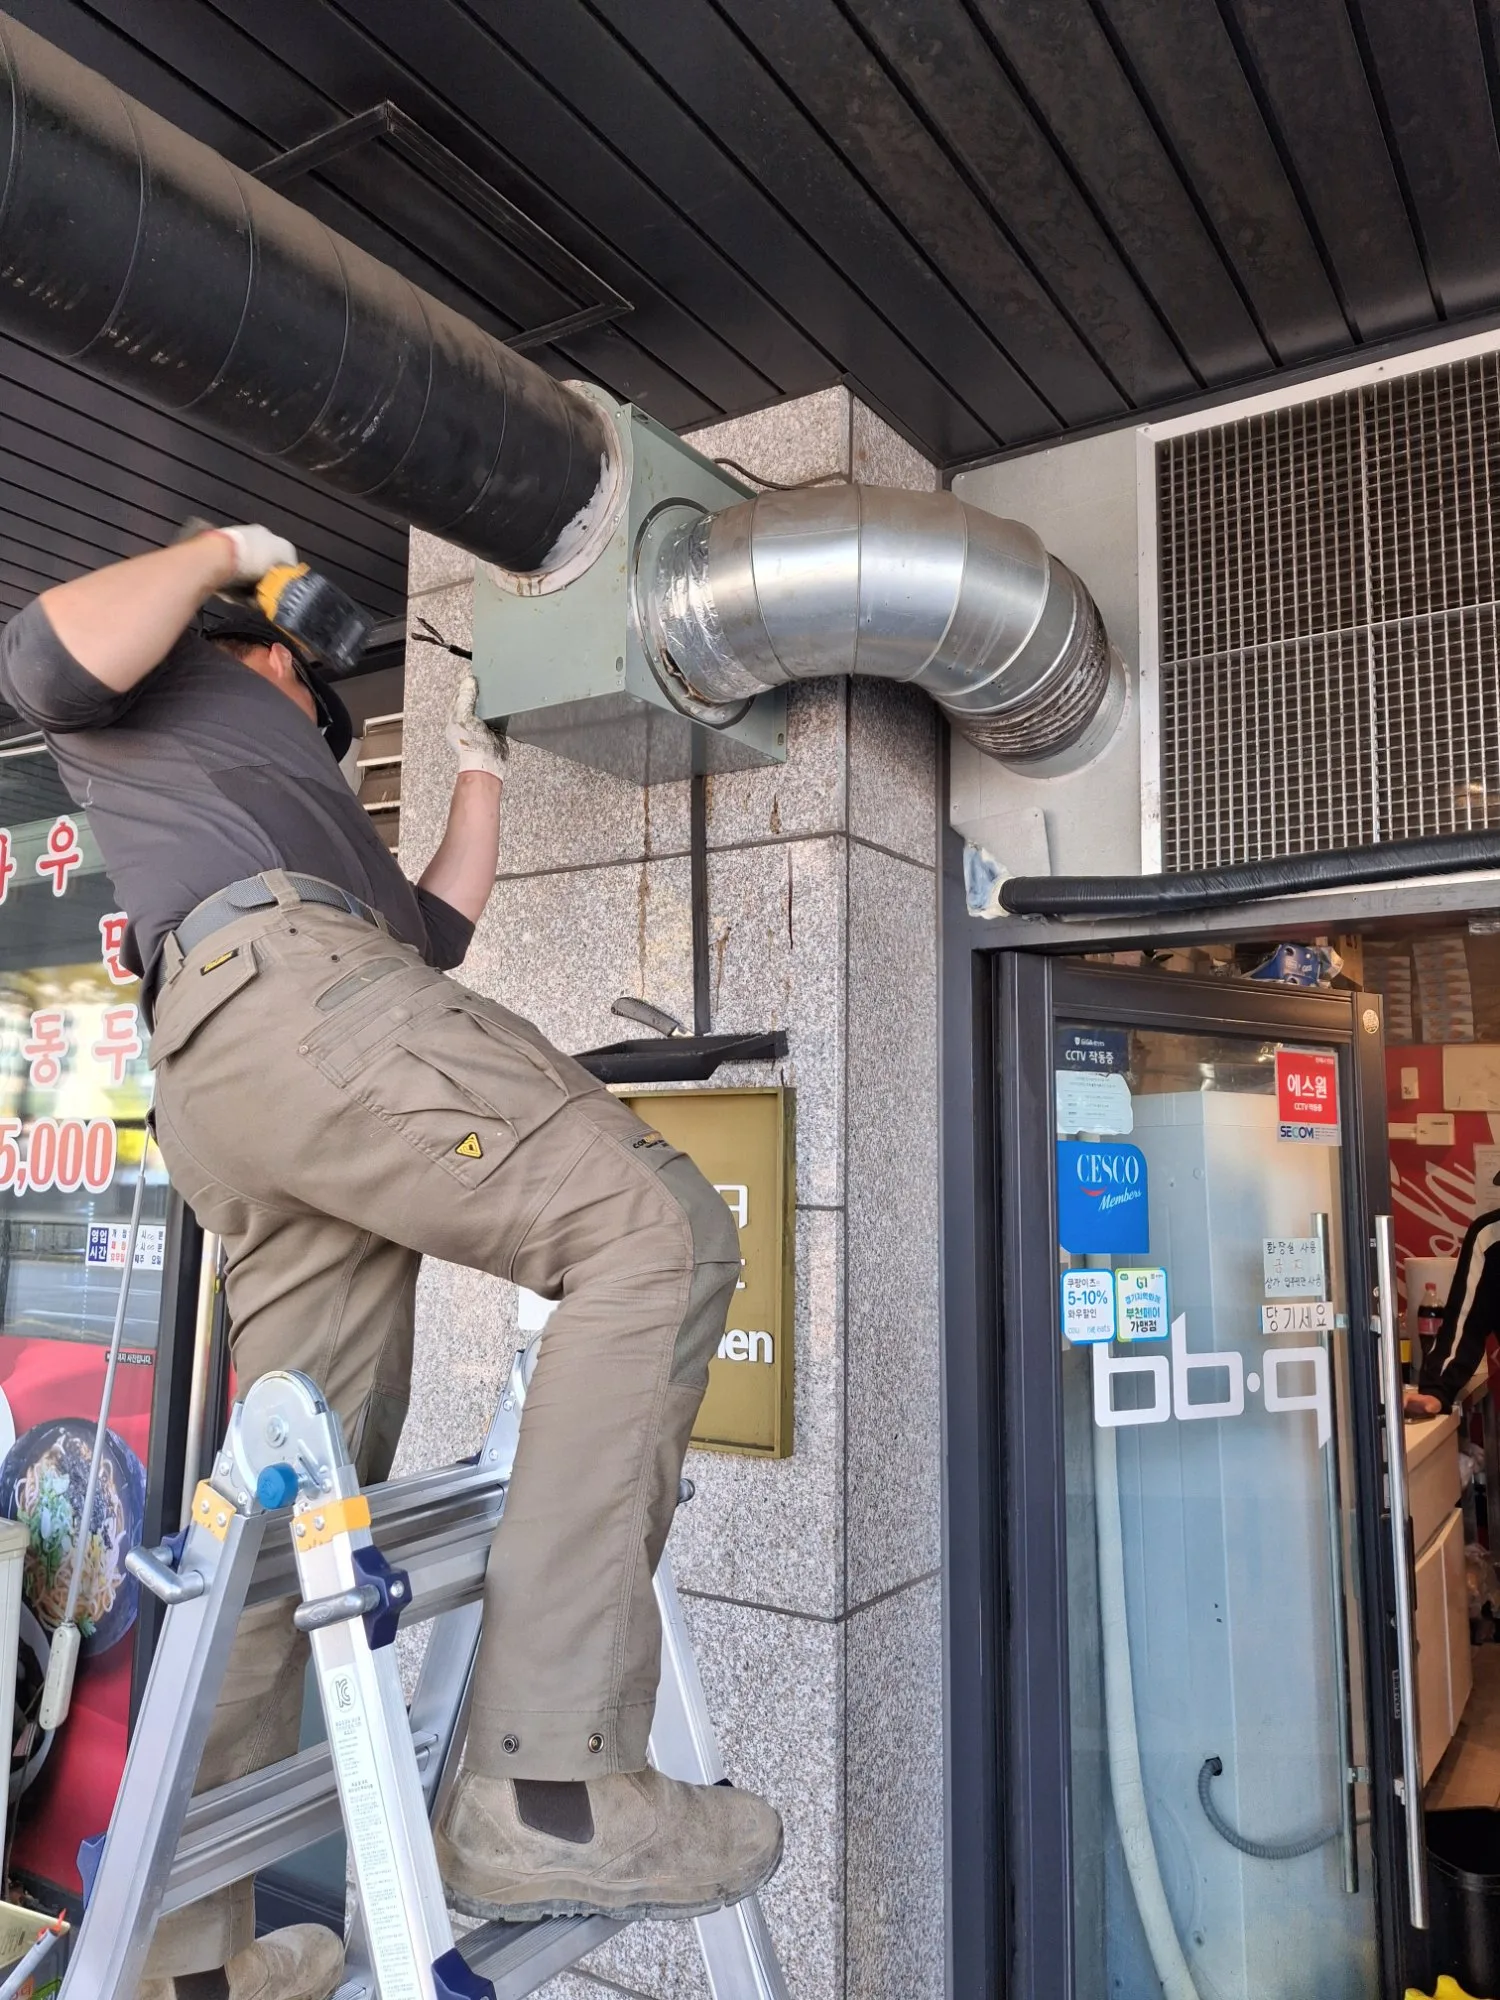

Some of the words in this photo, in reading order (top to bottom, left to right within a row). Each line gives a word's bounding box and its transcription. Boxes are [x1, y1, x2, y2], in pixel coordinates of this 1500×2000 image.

[1065, 1050, 1087, 1062] CCTV
[1088, 1051, 1114, 1065] 작동중
[1287, 1073, 1328, 1099] 에스원
[1280, 1126, 1314, 1139] SECOM
[1077, 1154, 1140, 1185] CESCO
[1098, 1187, 1142, 1212] Members
[91, 1229, 108, 1244] 영업
[89, 1245, 107, 1260] 시간
[1267, 1241, 1295, 1255] 화장실
[1301, 1241, 1316, 1254] 사용
[1068, 1290, 1108, 1306] 5-10%
[1067, 1308, 1097, 1319] 와우할인
[1126, 1306, 1160, 1319] 부천페이
[1266, 1304, 1327, 1332] 당기세요
[1130, 1320, 1157, 1333] 가맹점
